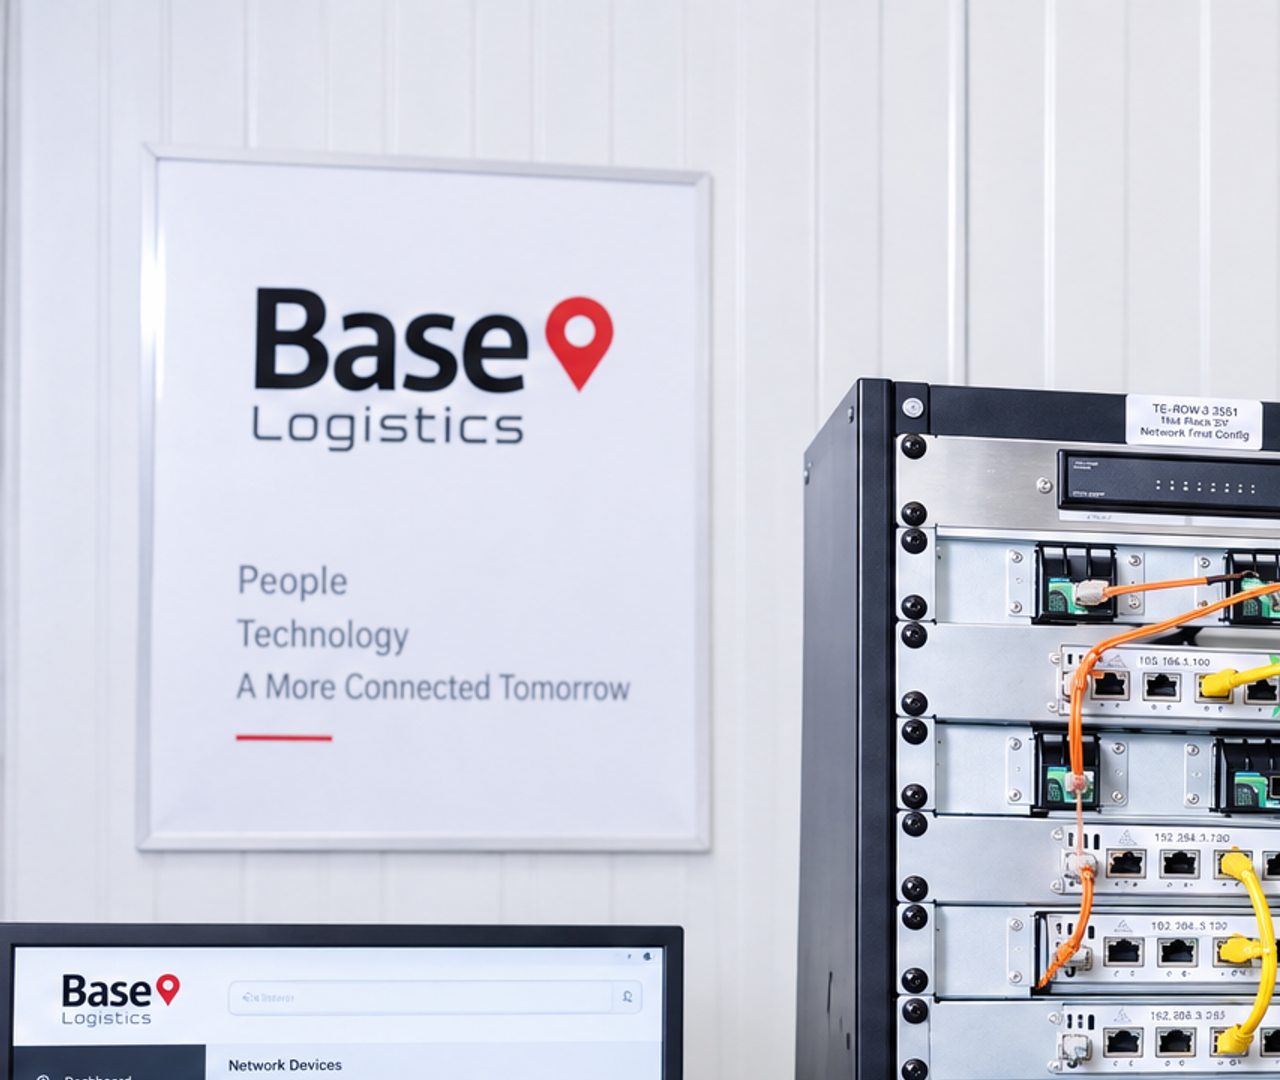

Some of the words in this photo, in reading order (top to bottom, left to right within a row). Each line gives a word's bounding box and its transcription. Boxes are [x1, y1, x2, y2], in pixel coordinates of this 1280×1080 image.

[254, 287, 529, 394] Base
[252, 405, 524, 453] Logistics
[238, 564, 348, 603] People
[236, 618, 410, 657] Technology
[236, 672, 257, 700] A
[266, 672, 337, 701] More
[344, 672, 491, 701] Connected
[498, 673, 631, 702] Tomorrow
[62, 973, 152, 1008] Base
[61, 1010, 152, 1029] Logistics
[228, 1058, 286, 1072] Network
[289, 1058, 343, 1072] Devices
